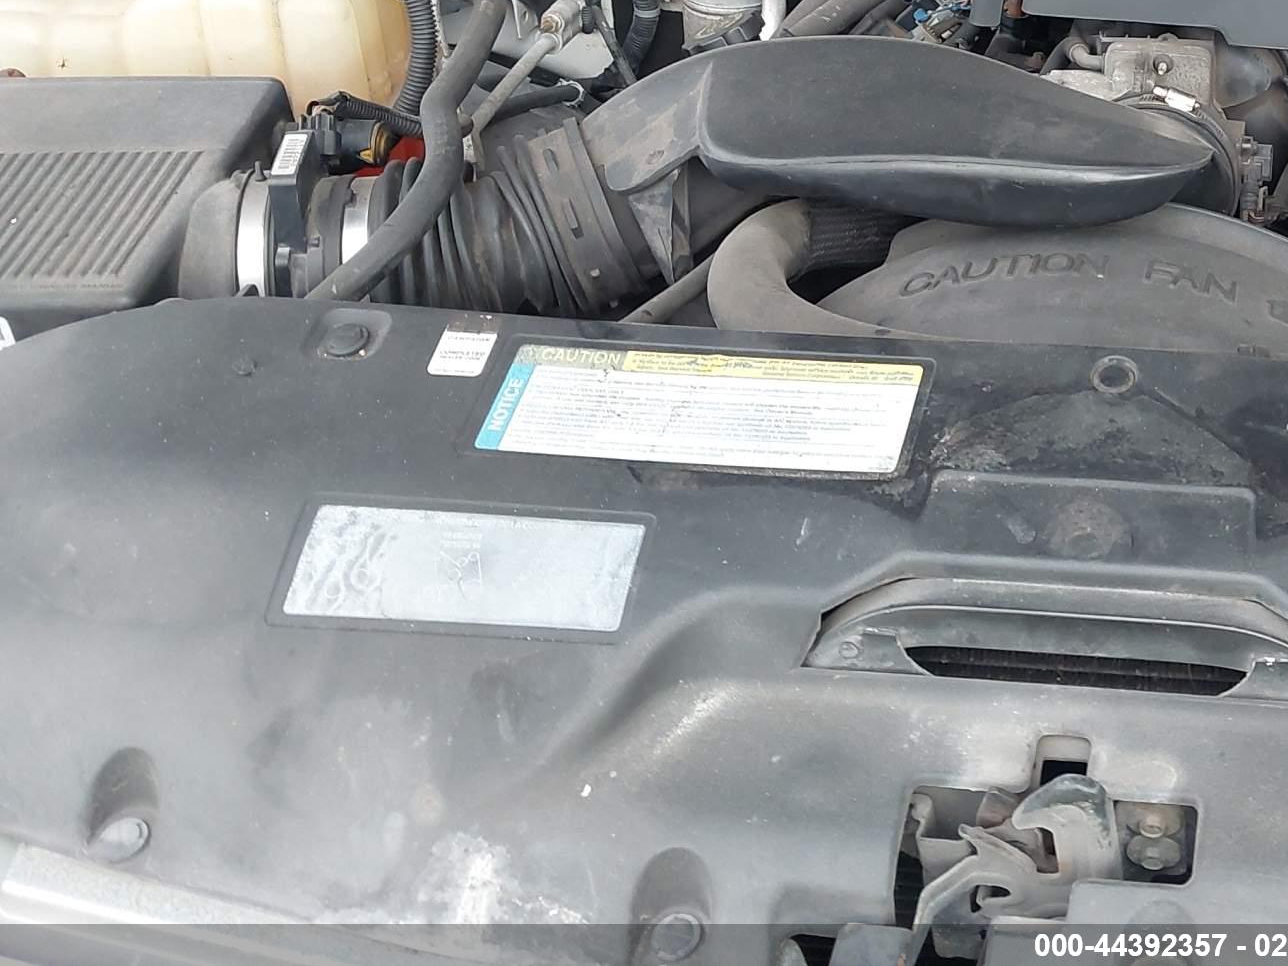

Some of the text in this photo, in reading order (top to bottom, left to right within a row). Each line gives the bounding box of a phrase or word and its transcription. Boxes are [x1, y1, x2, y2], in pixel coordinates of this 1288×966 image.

[899, 250, 1239, 303] CAUTION FAN
[541, 346, 621, 365] CAUTION
[487, 377, 524, 432] NOTICE
